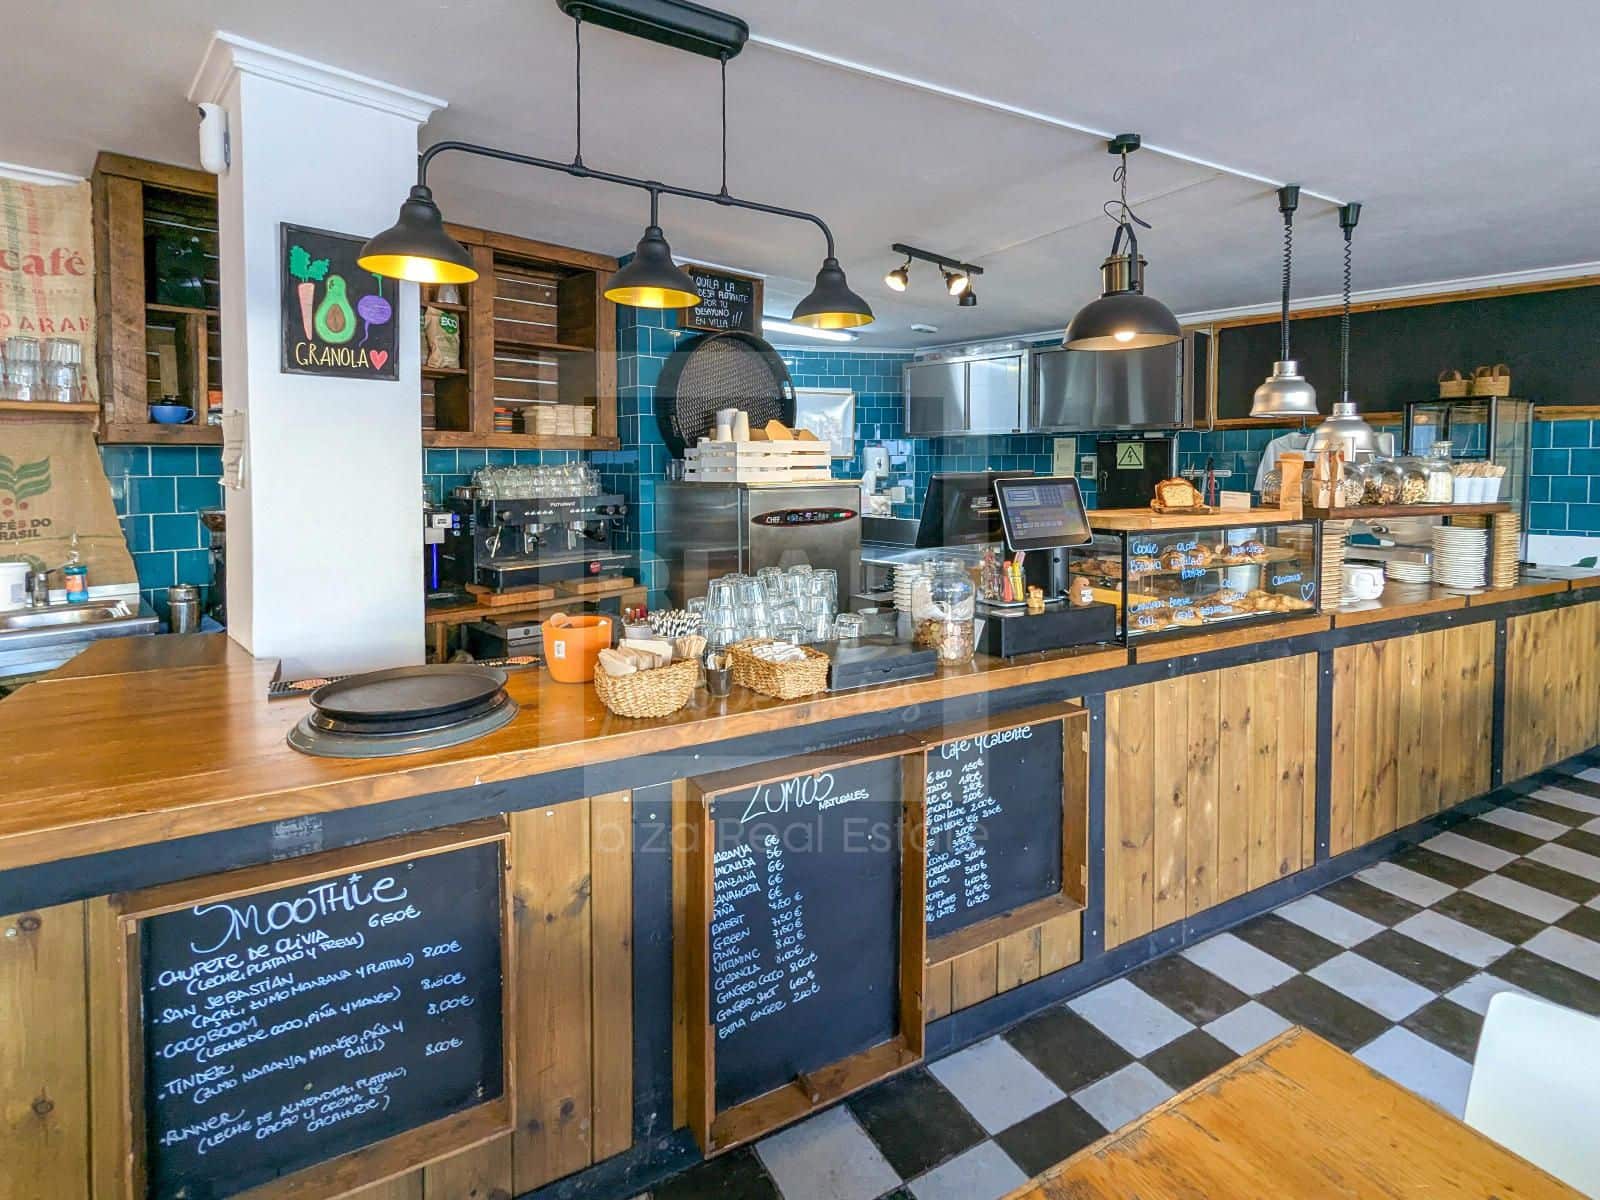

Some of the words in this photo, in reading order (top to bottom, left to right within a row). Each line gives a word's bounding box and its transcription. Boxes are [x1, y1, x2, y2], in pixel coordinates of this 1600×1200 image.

[725, 282, 735, 292] LA
[704, 298, 717, 307] POR
[720, 300, 728, 308] TU
[695, 307, 730, 317] DESAYUNO
[441, 317, 457, 329] ECO
[695, 316, 706, 325] EN
[708, 318, 728, 328] VILLA
[295, 342, 370, 368] GRANOLA
[30, 518, 51, 528] DO
[766, 845, 783, 860] 5€
[767, 860, 784, 873] 6€
[768, 873, 784, 886] 6€
[768, 886, 783, 900] 6€
[713, 927, 750, 950] GREEN
[248, 944, 270, 960] DE
[162, 1004, 197, 1023] SAN
[165, 1064, 235, 1095] TINDER
[256, 1111, 272, 1125] DE
